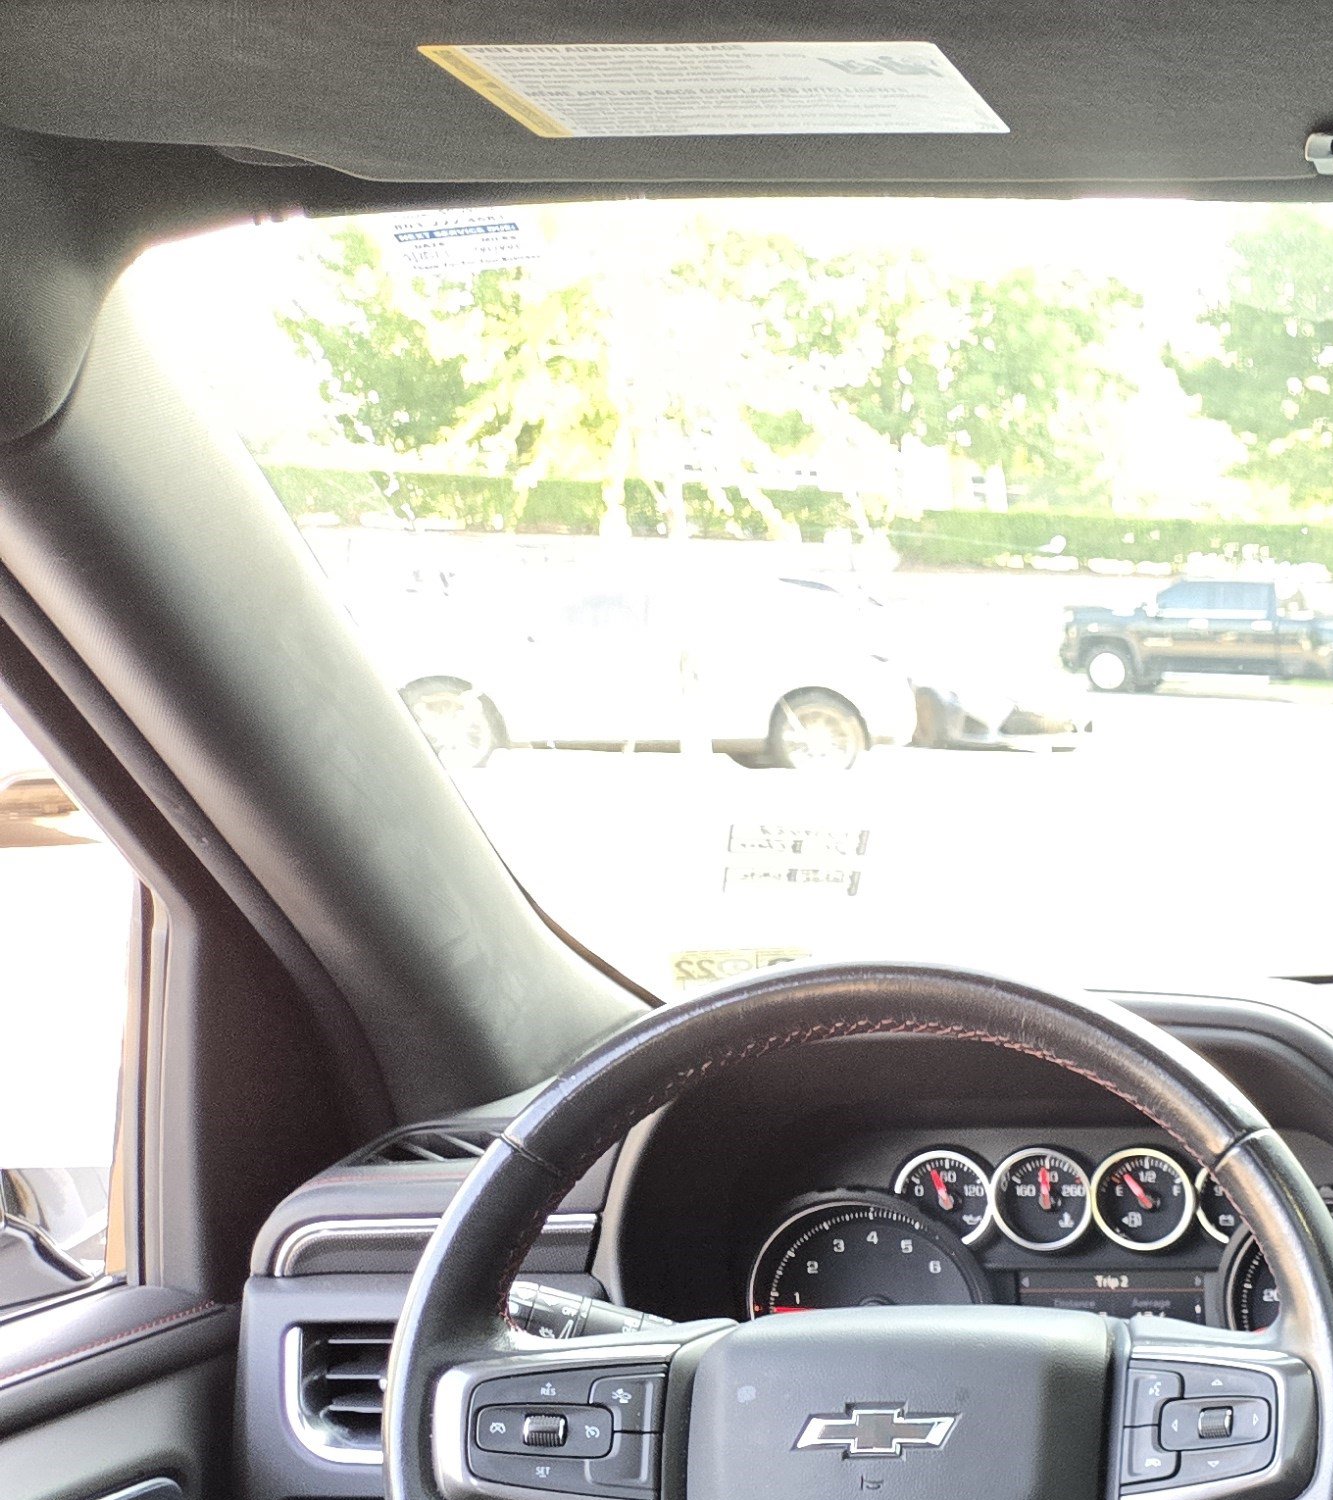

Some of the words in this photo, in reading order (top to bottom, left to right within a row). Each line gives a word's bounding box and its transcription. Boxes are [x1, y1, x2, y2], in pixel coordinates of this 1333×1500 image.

[1139, 1170, 1156, 1184] 1/2
[964, 1184, 984, 1196] 120
[1016, 1184, 1036, 1196] 160
[866, 1231, 878, 1244] 4
[832, 1238, 845, 1252] 3
[900, 1239, 913, 1254] 5
[806, 1260, 818, 1274] 2
[929, 1260, 942, 1274] 6
[1094, 1274, 1119, 1290] Trip
[1120, 1275, 1130, 1288] 2
[540, 1387, 556, 1396] RES
[536, 1466, 550, 1476] SET
